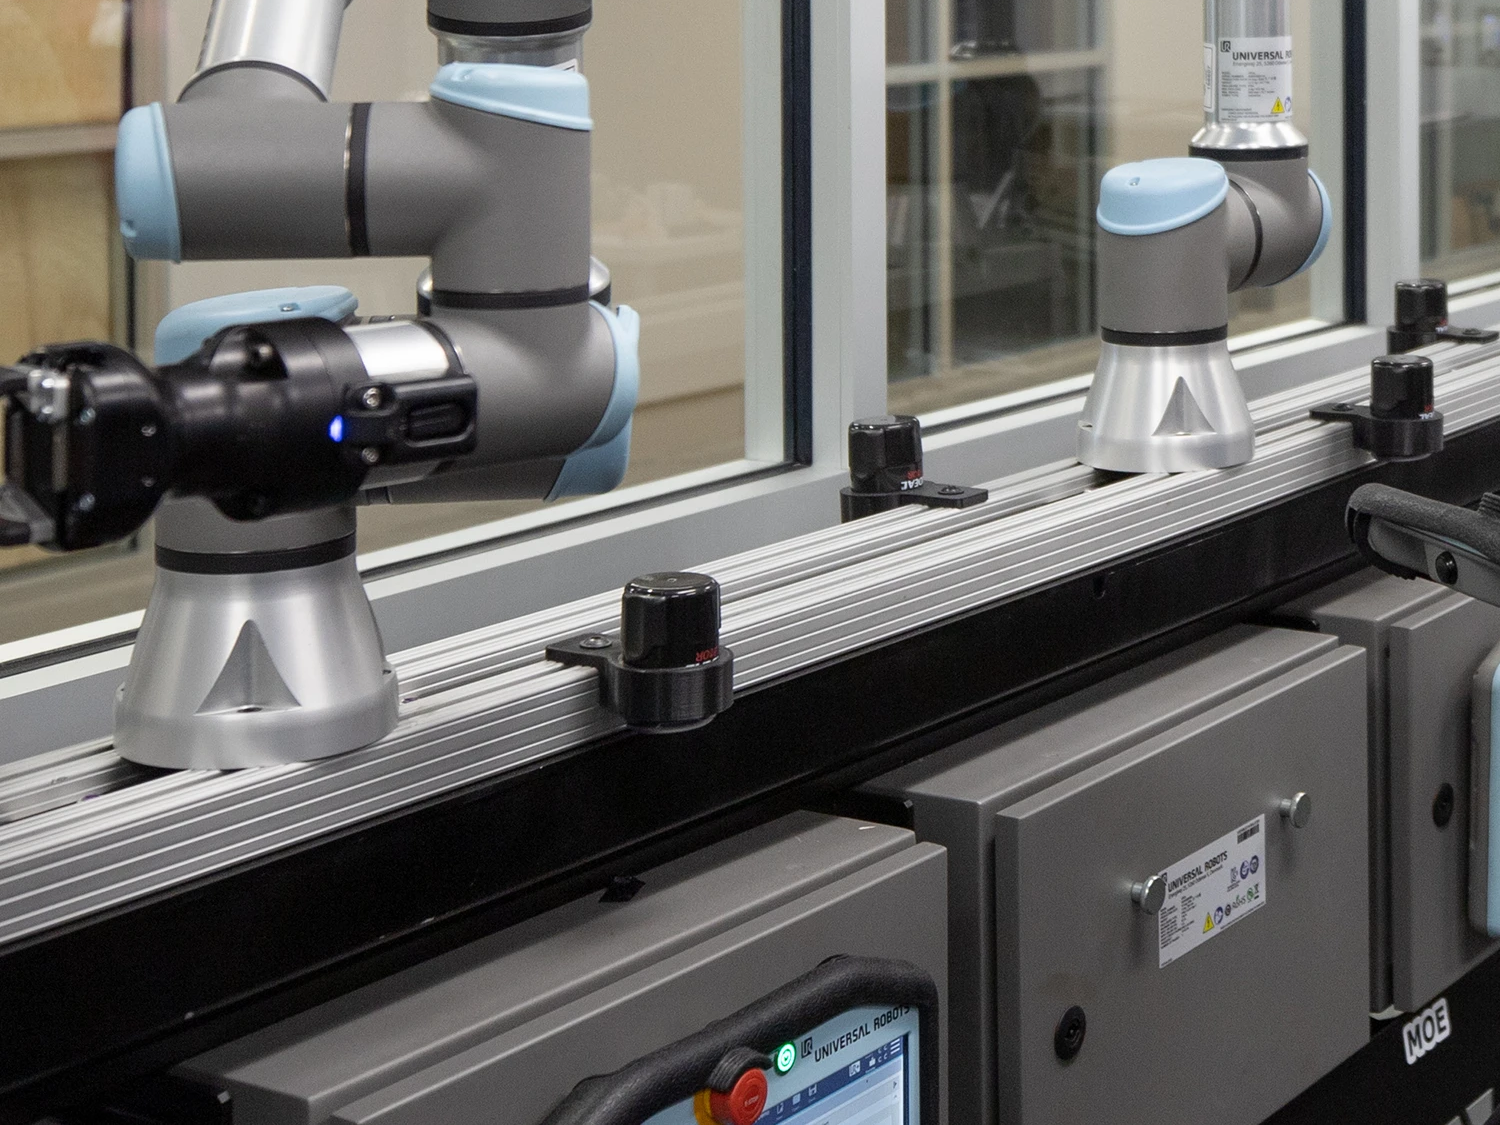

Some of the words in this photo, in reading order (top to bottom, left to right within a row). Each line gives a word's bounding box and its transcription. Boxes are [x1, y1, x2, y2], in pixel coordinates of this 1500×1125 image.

[1232, 51, 1284, 61] UNIVERSAL
[1168, 865, 1203, 893] UNIVERSAL
[1204, 850, 1228, 872] ROBOTS
[814, 1023, 871, 1062] UNIVERSAL
[873, 1006, 910, 1032] ROBOTS
[1407, 1005, 1447, 1057] MOE
